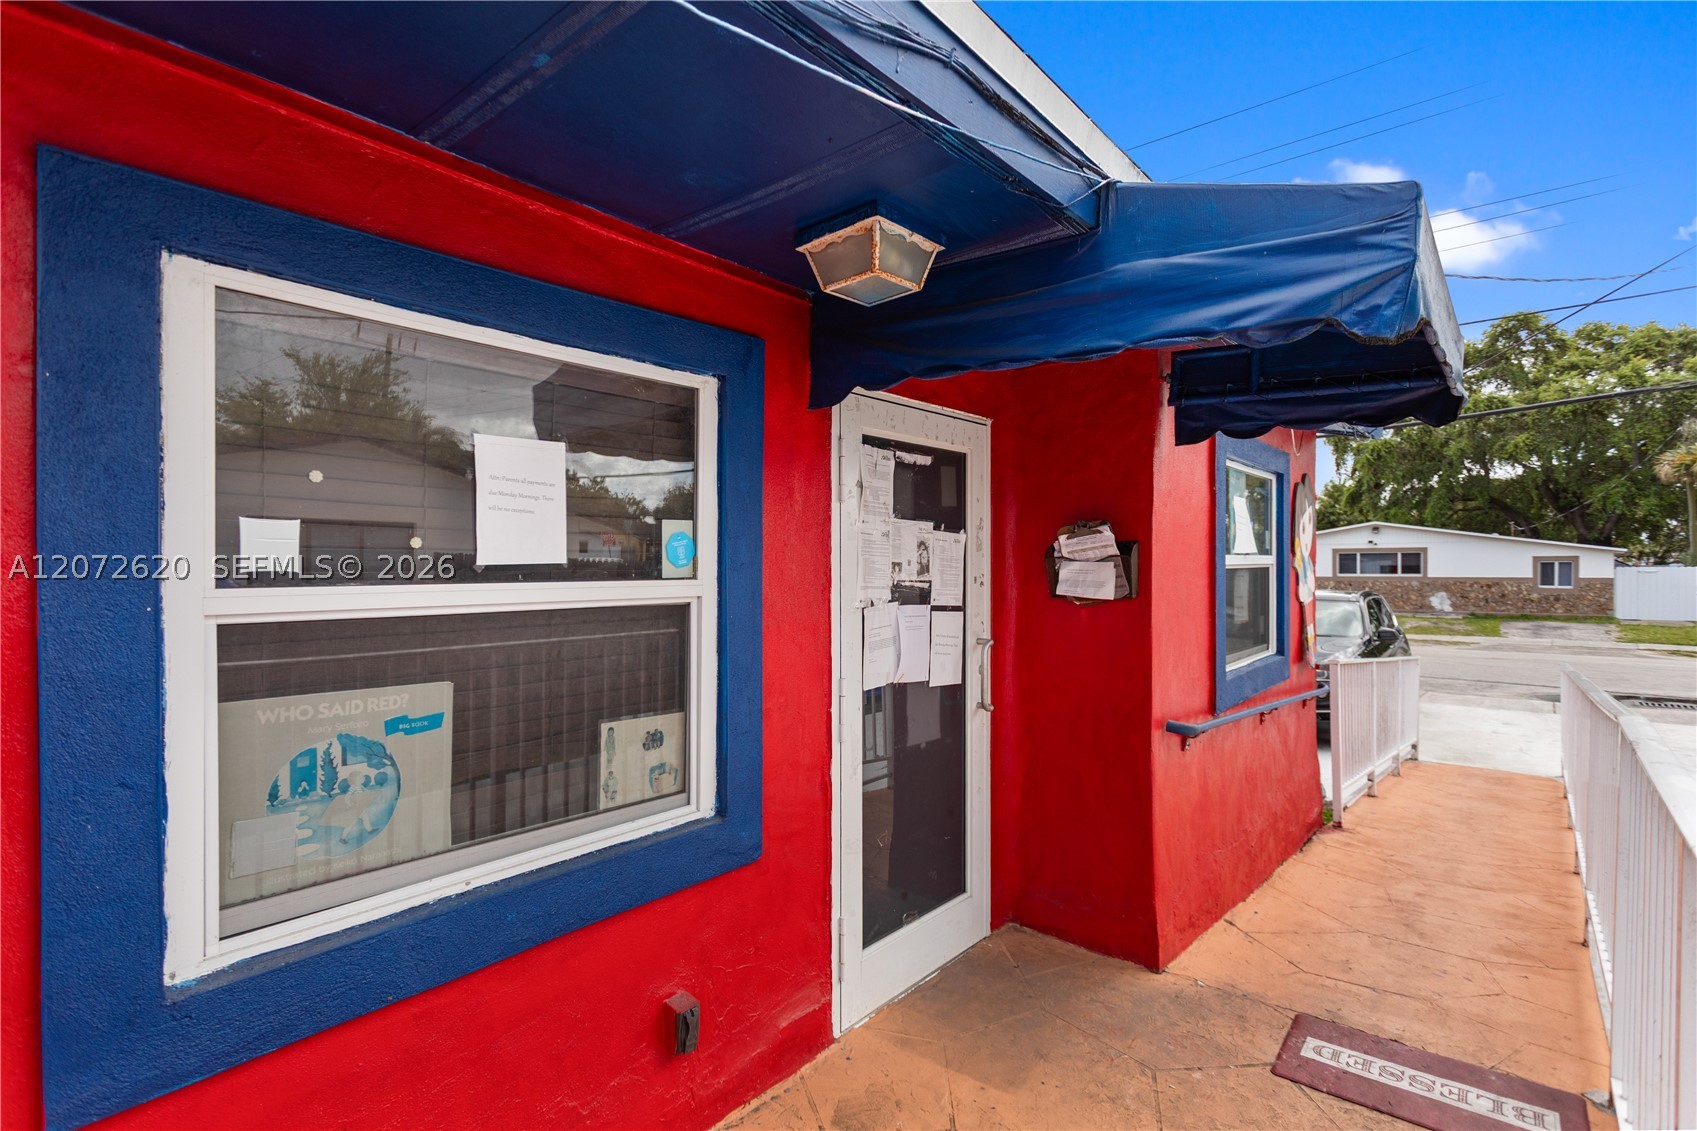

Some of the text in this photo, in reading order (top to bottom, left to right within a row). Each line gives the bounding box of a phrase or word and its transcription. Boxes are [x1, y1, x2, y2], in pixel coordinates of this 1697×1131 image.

[501, 475, 520, 483] Parents
[498, 490, 517, 499] Monday
[257, 693, 410, 724] WHO SAID RED?
[307, 724, 333, 735] Mary
[398, 720, 429, 730] BIG BOOK
[1312, 1044, 1550, 1128] BLESSED
